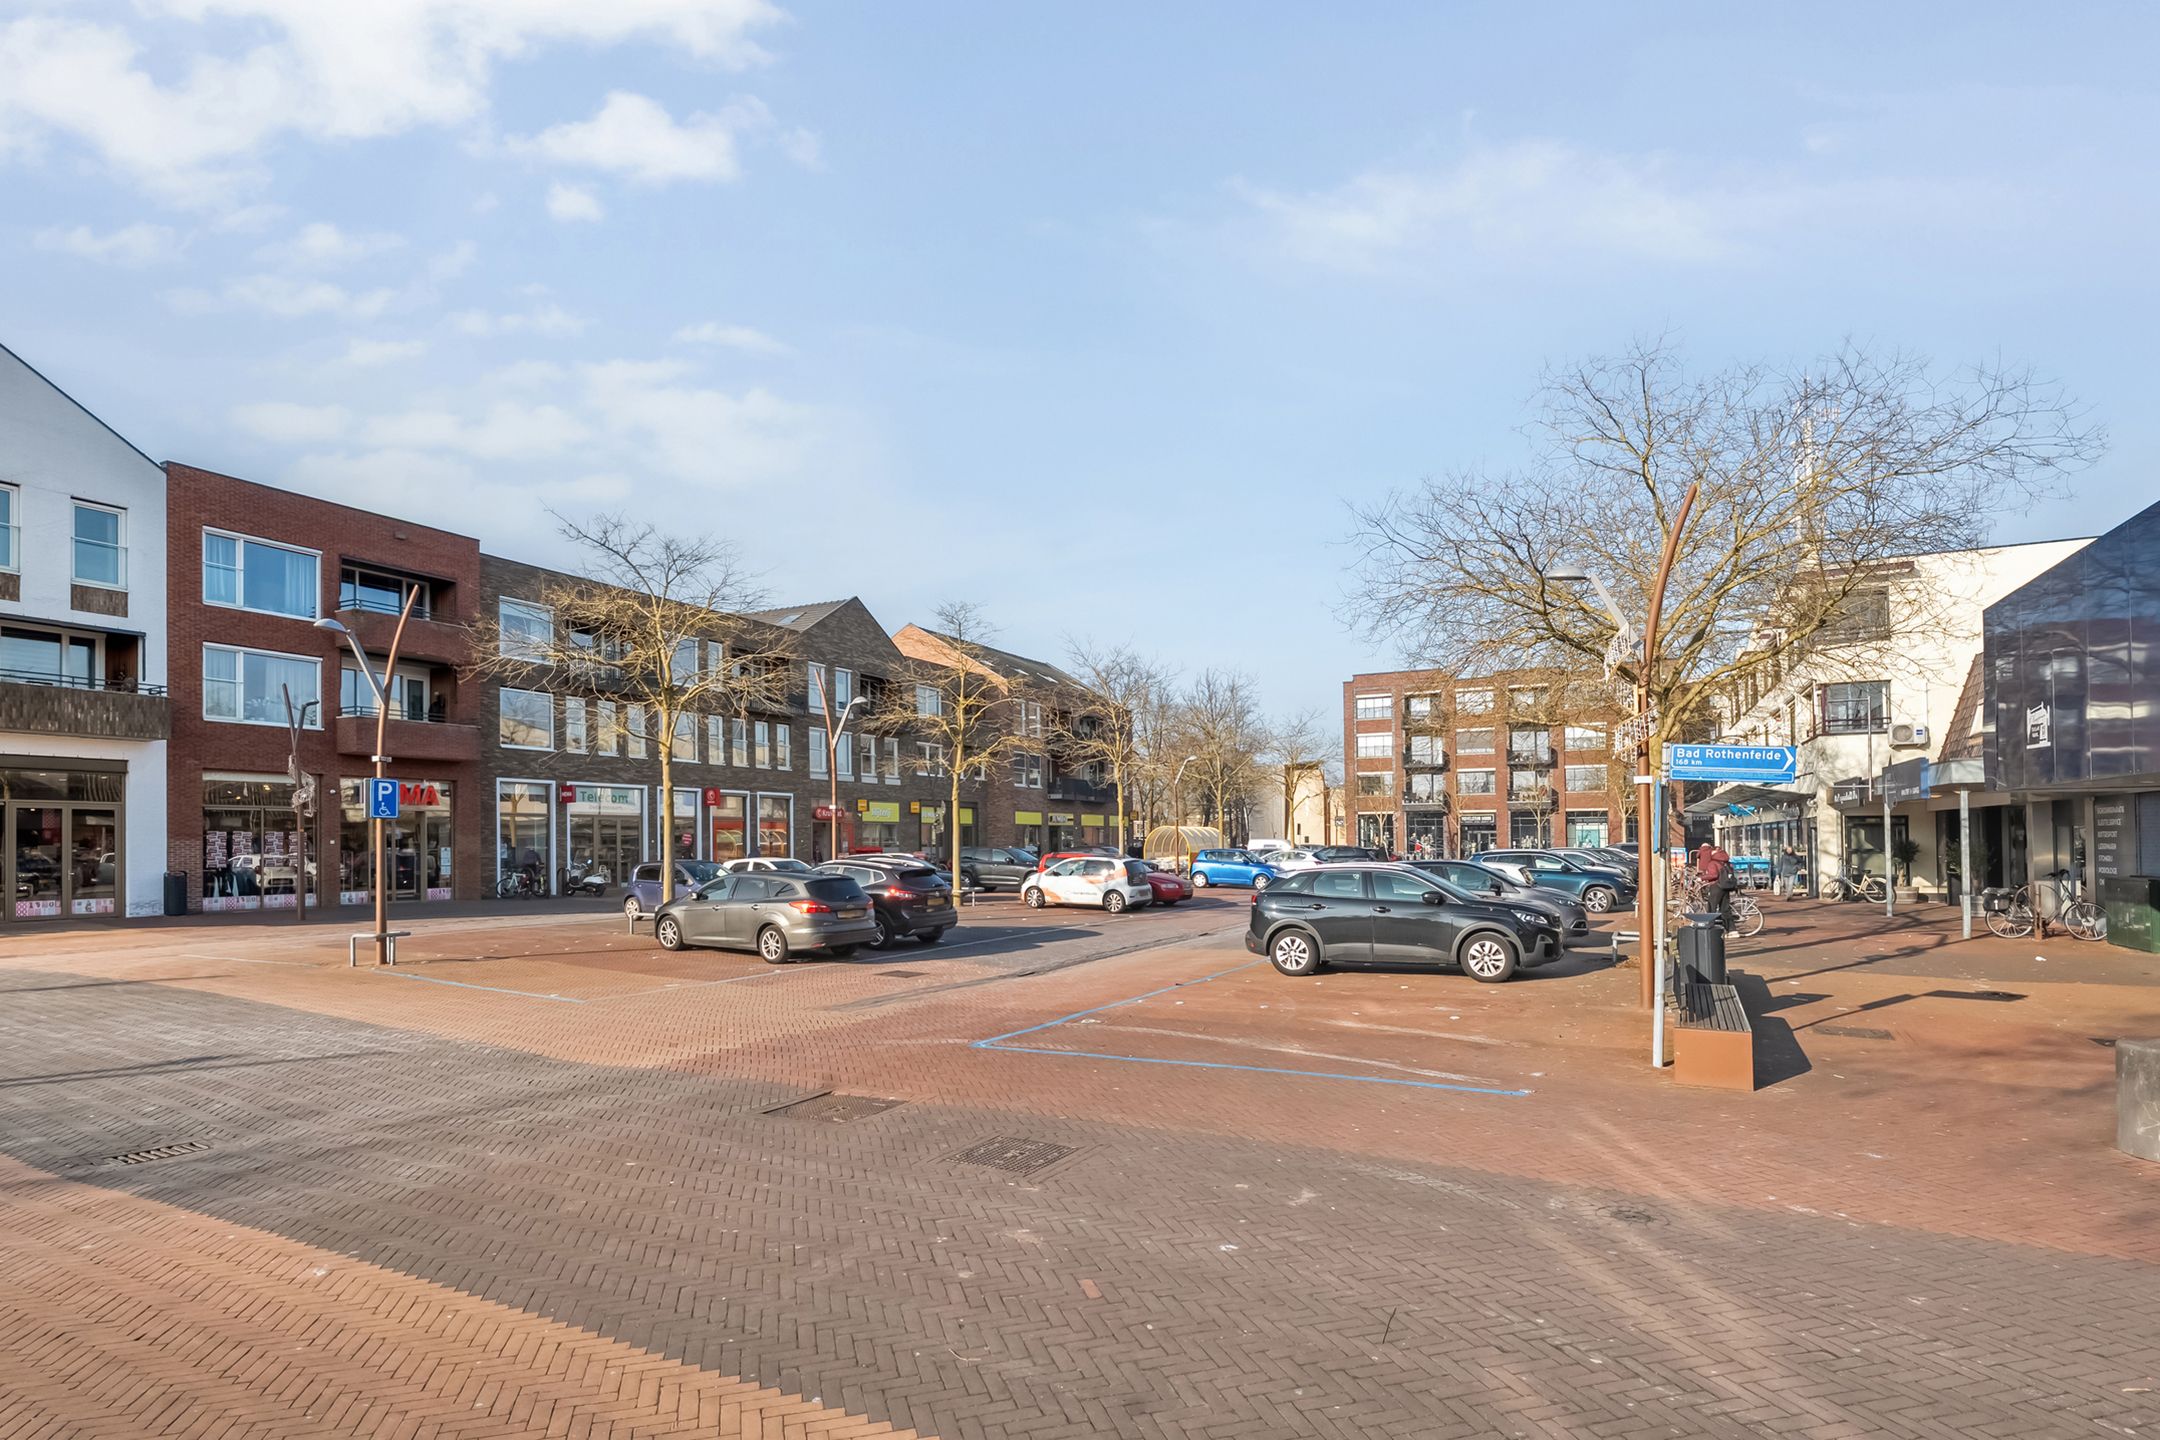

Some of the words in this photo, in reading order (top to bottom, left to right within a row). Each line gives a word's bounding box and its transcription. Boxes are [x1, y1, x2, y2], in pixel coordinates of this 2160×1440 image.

[1676, 748, 1700, 759] Bad
[1705, 749, 1781, 760] Rothenfelde
[378, 782, 393, 801] P
[400, 783, 440, 806] MA
